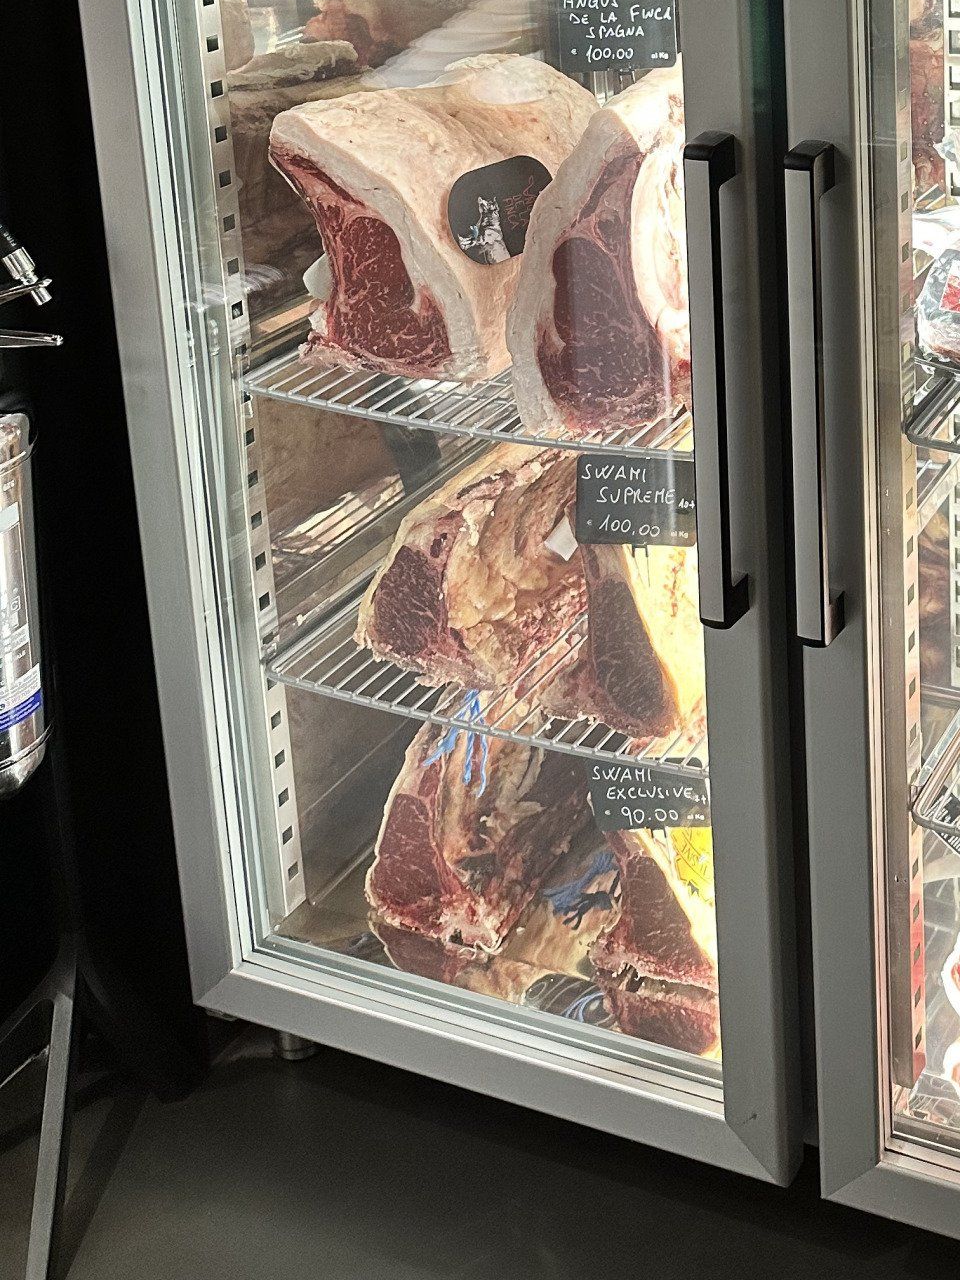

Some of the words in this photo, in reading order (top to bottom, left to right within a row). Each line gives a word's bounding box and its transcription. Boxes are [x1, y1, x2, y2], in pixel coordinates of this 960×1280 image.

[569, 12, 590, 25] DE
[600, 11, 618, 24] LA
[585, 24, 645, 40] SPAGNA
[581, 463, 647, 483] SWAMI
[596, 486, 676, 505] SUPREME
[591, 765, 652, 783] SWAMI
[606, 785, 694, 800] EXCLUSIVE
[620, 806, 679, 827] 90.00
